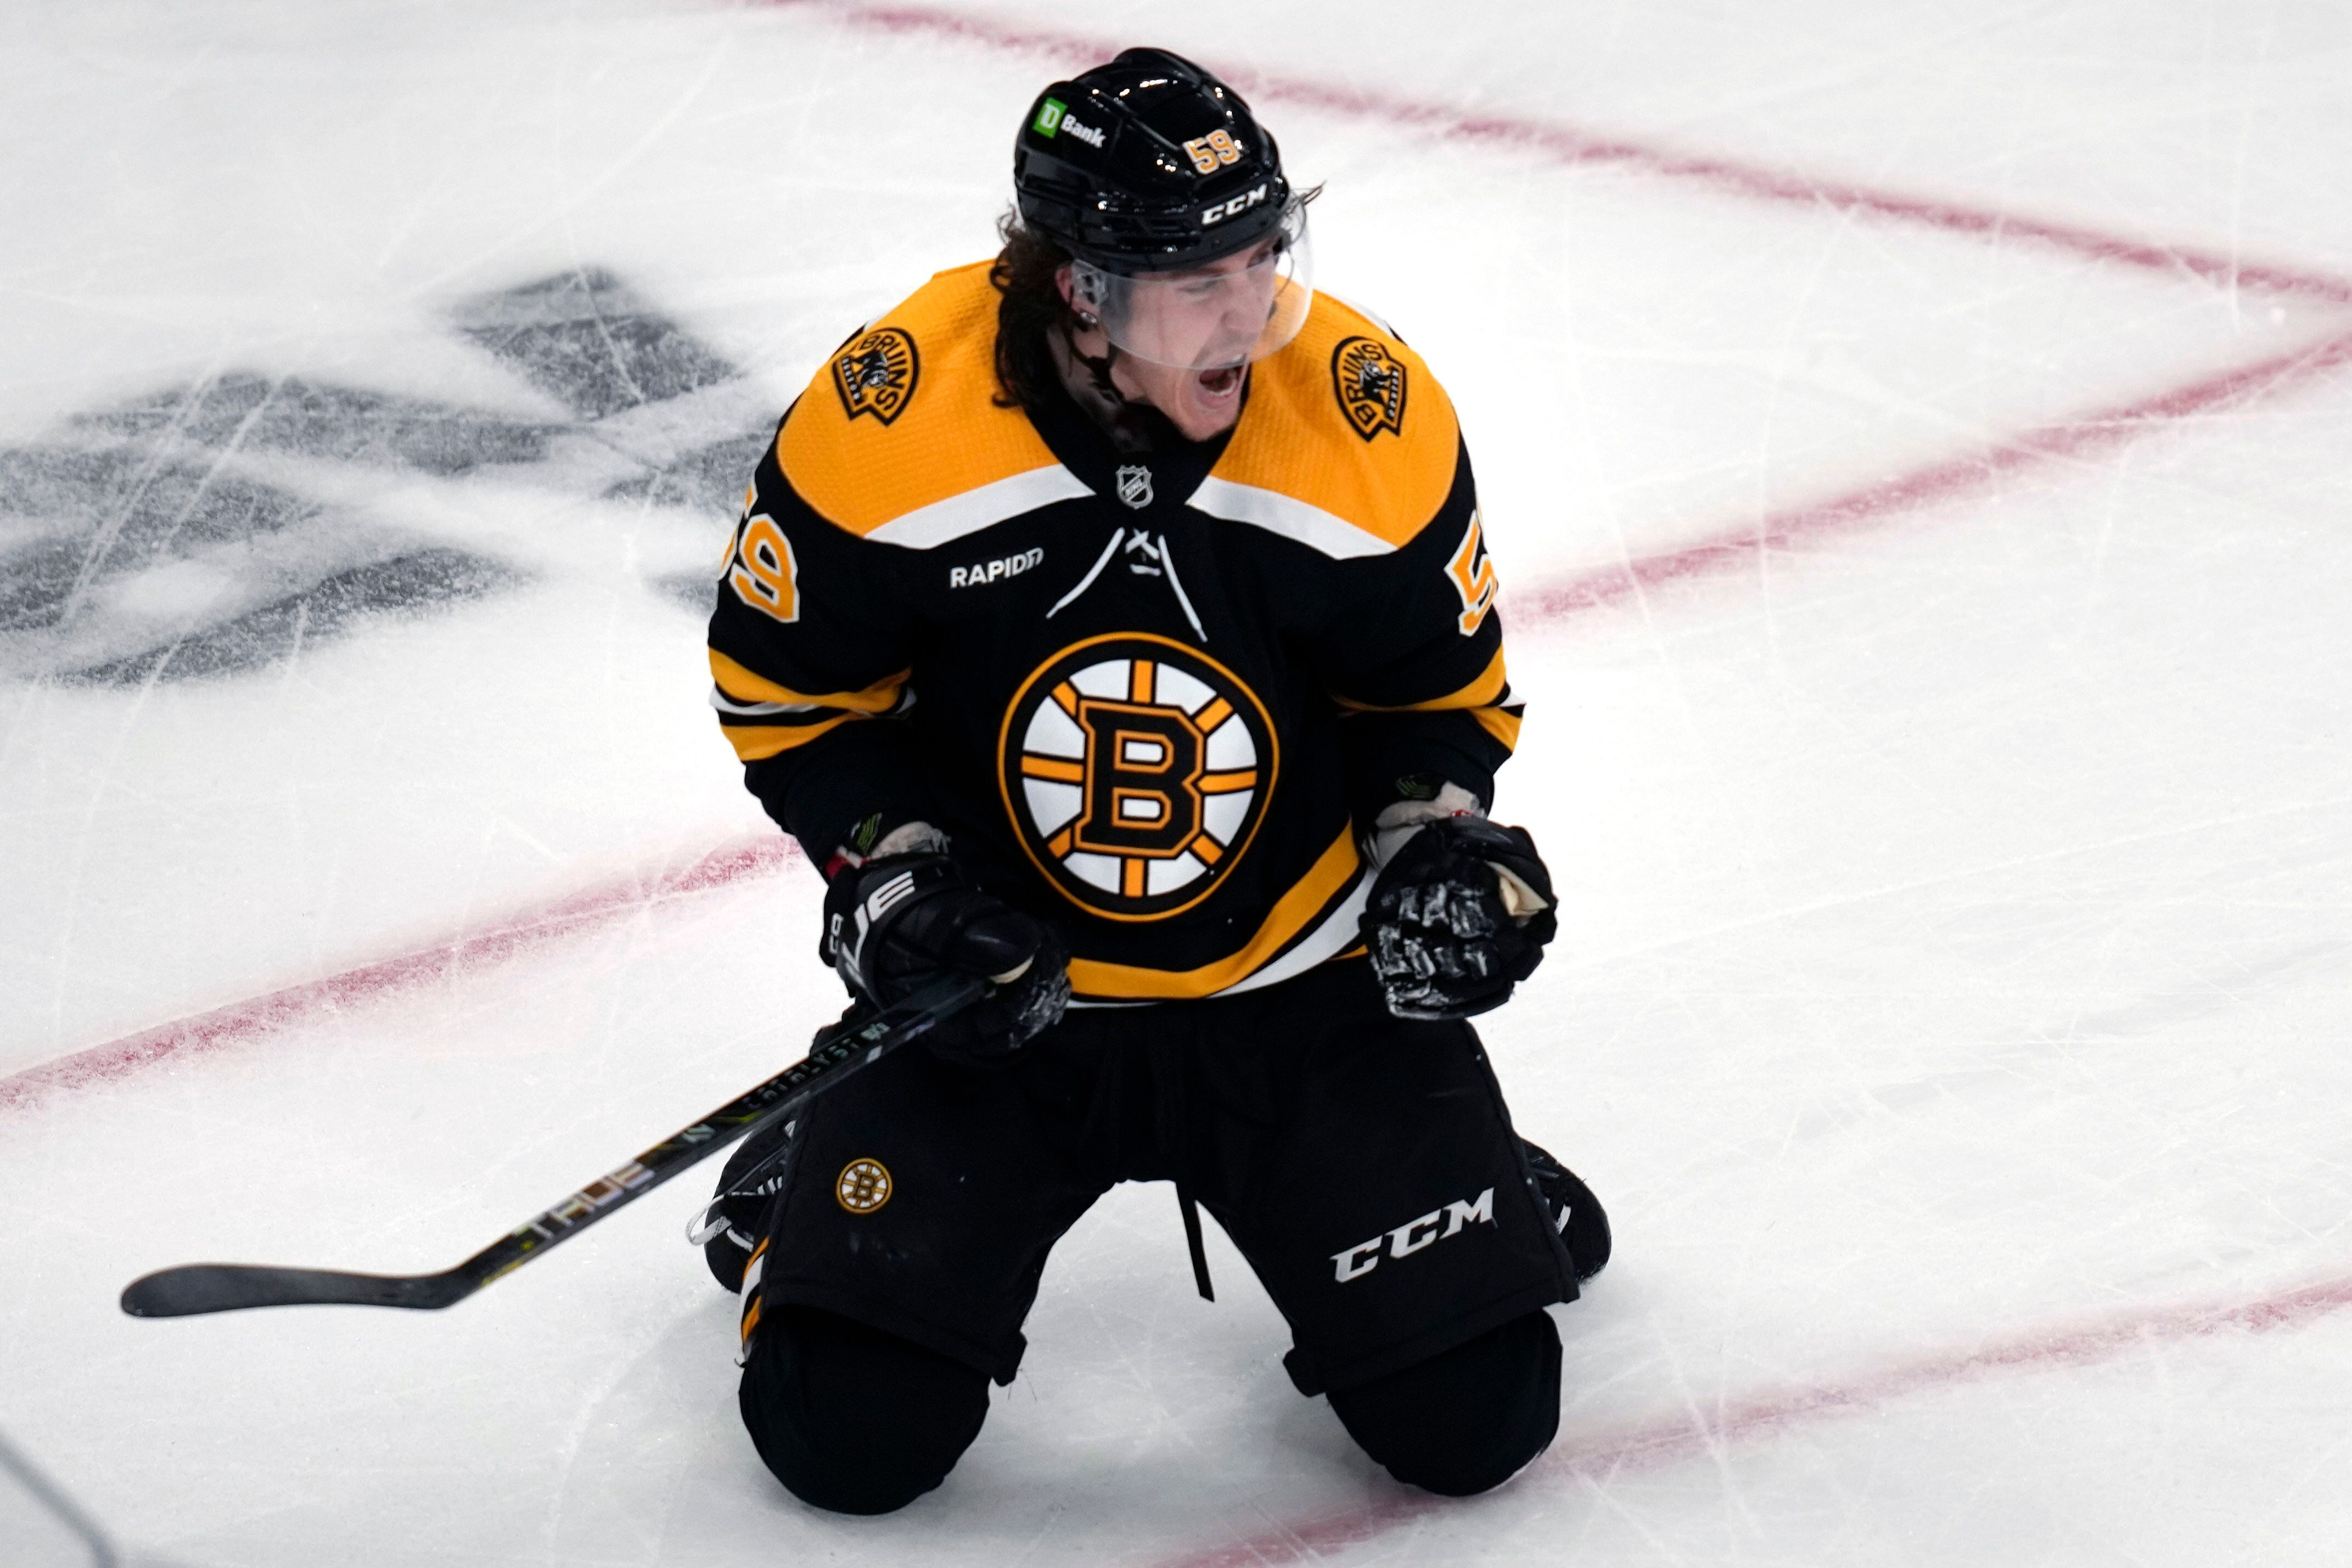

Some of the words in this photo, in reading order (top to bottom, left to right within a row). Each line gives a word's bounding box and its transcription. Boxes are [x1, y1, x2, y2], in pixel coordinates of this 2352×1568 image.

[1060, 113, 1107, 148] Bank
[1182, 128, 1241, 175] 59
[1201, 184, 1268, 225] CCM
[860, 334, 907, 411] BRUINS
[1343, 342, 1382, 426] BRUINS
[718, 480, 800, 623] 9
[1444, 502, 1500, 637] 5
[1074, 700, 1209, 858] B
[1329, 1187, 1494, 1283] CCM
